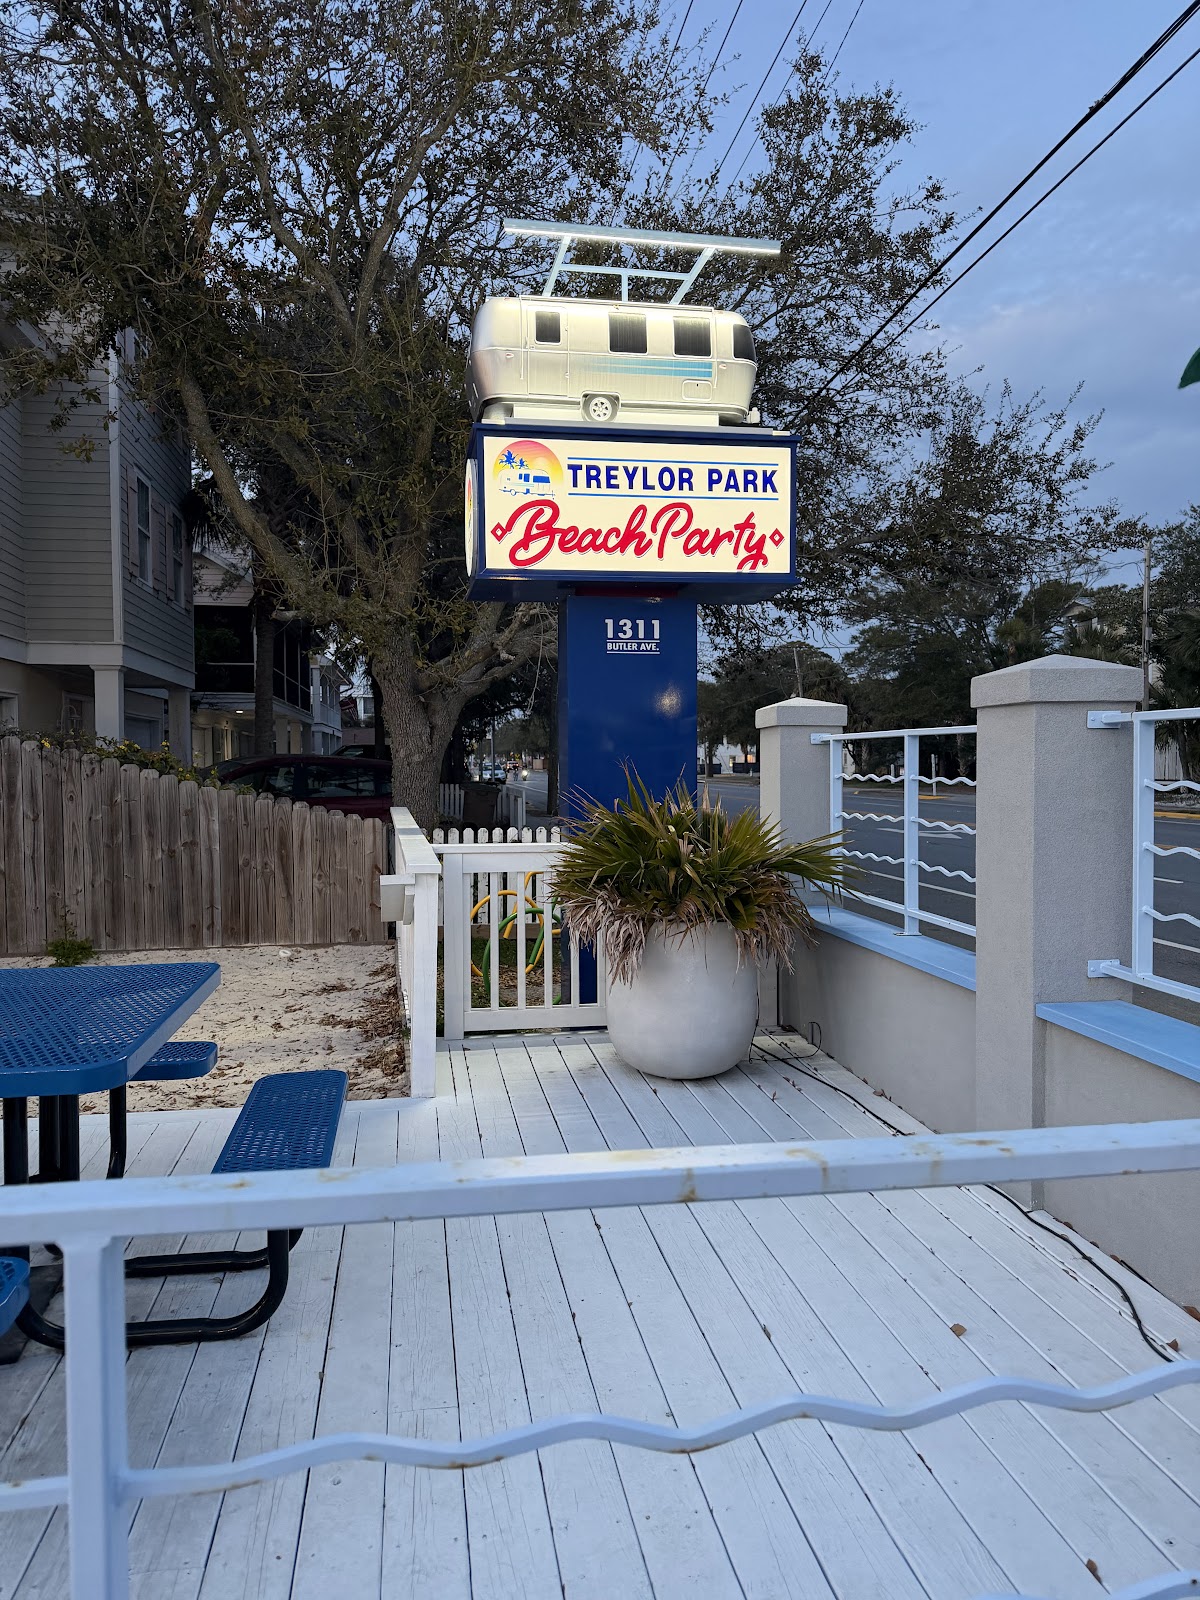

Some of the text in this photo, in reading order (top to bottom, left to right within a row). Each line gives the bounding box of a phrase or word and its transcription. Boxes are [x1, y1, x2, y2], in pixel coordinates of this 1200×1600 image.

[567, 464, 779, 493] TREYLOR PARK
[504, 499, 654, 567] Beach
[651, 502, 769, 570] Party
[604, 618, 660, 639] 1311
[606, 642, 660, 652] BUTLER AVE.
